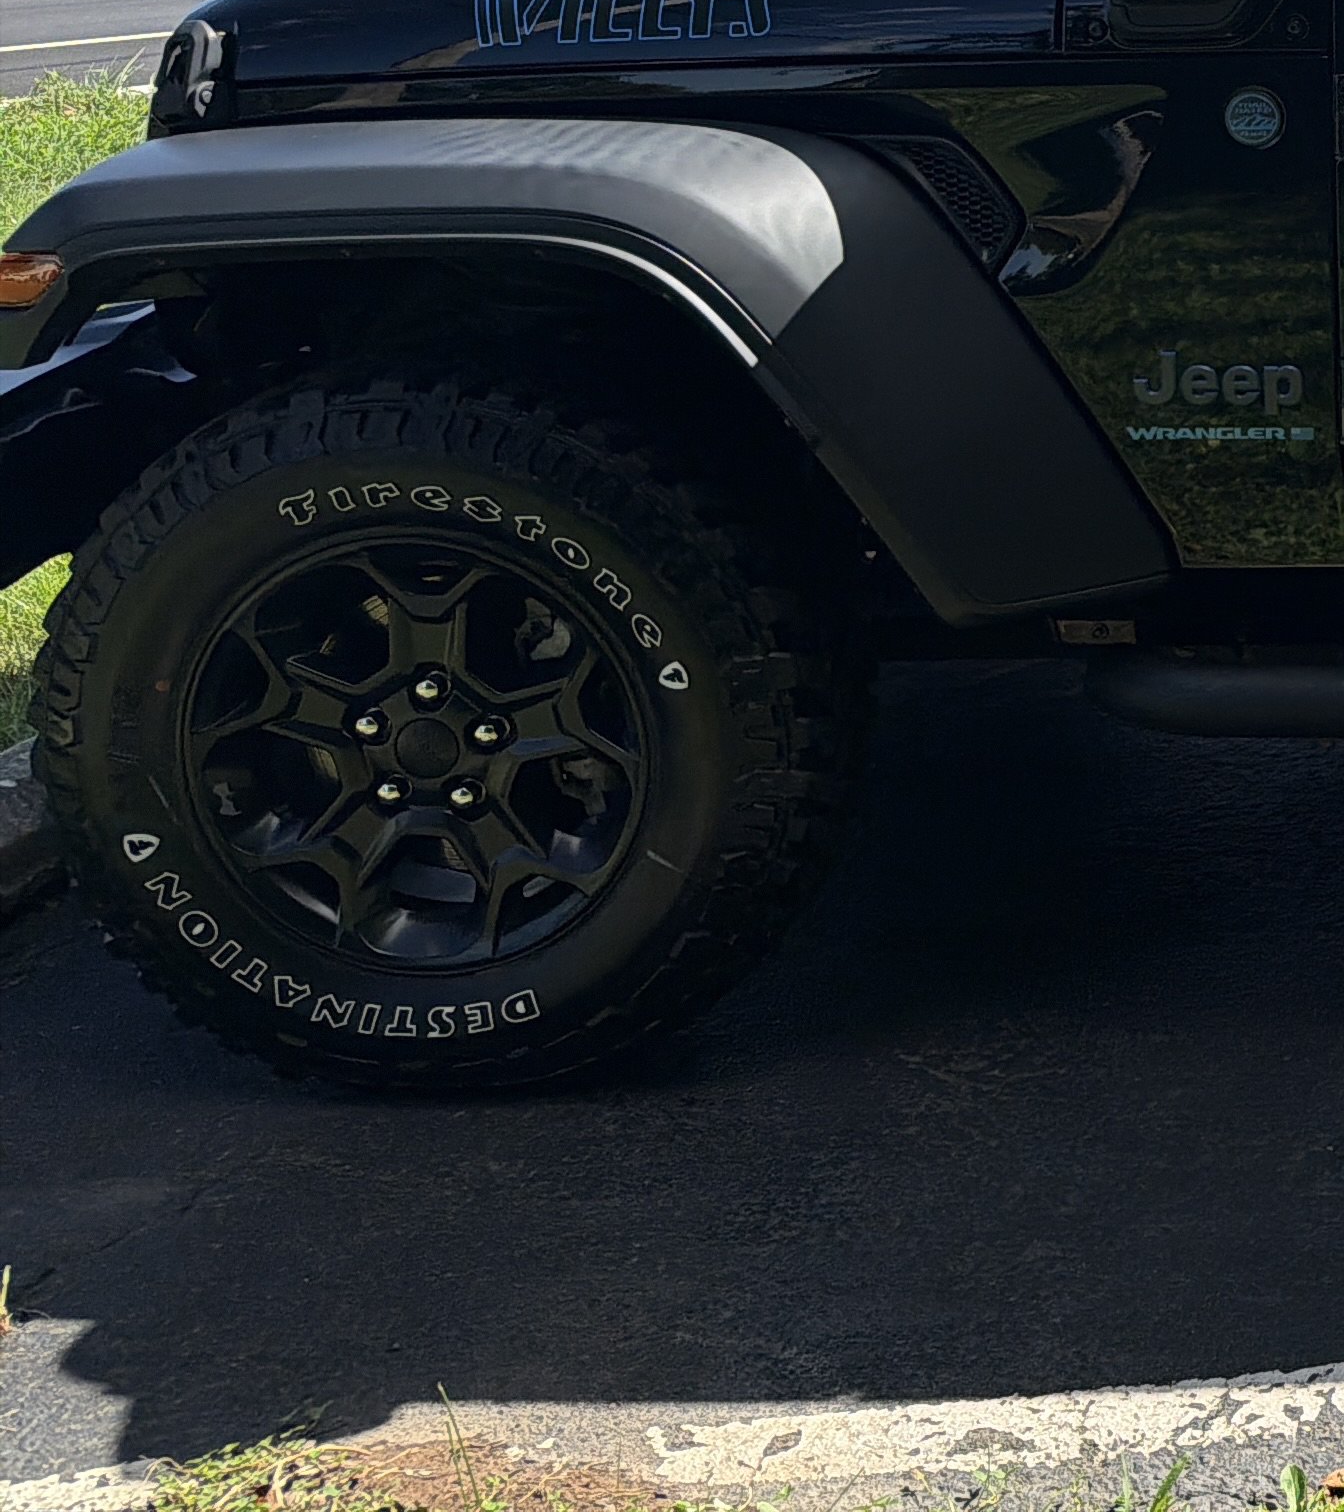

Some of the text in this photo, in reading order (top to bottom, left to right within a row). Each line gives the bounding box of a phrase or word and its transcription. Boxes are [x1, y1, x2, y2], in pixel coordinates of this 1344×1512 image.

[1126, 426, 1287, 441] WRANGLER
[1132, 349, 1304, 416] Jeep
[277, 481, 665, 651] Firestone
[143, 869, 542, 1039] DESTINATION
